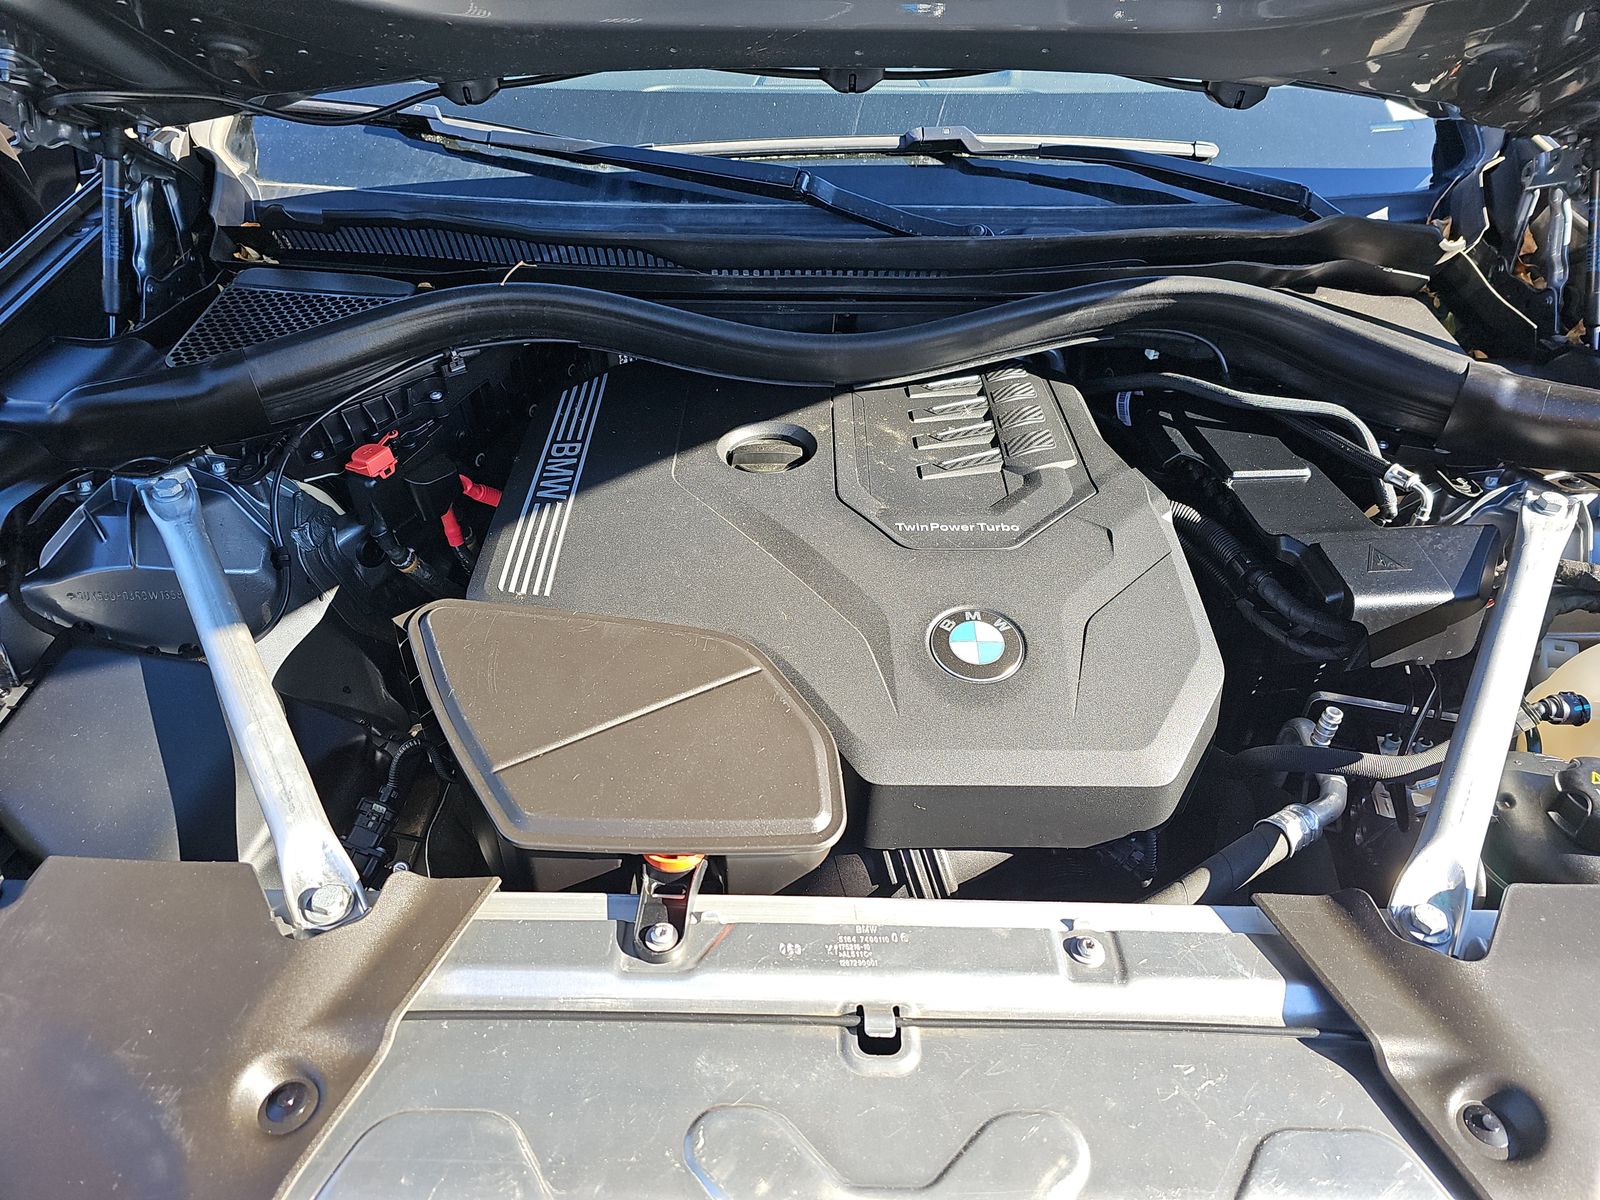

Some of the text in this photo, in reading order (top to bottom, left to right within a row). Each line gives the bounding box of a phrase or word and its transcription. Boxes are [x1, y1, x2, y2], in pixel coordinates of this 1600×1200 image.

[536, 442, 582, 500] BMW
[976, 522, 1020, 532] Turbo
[939, 611, 1011, 632] BMW
[856, 925, 878, 934] BMW
